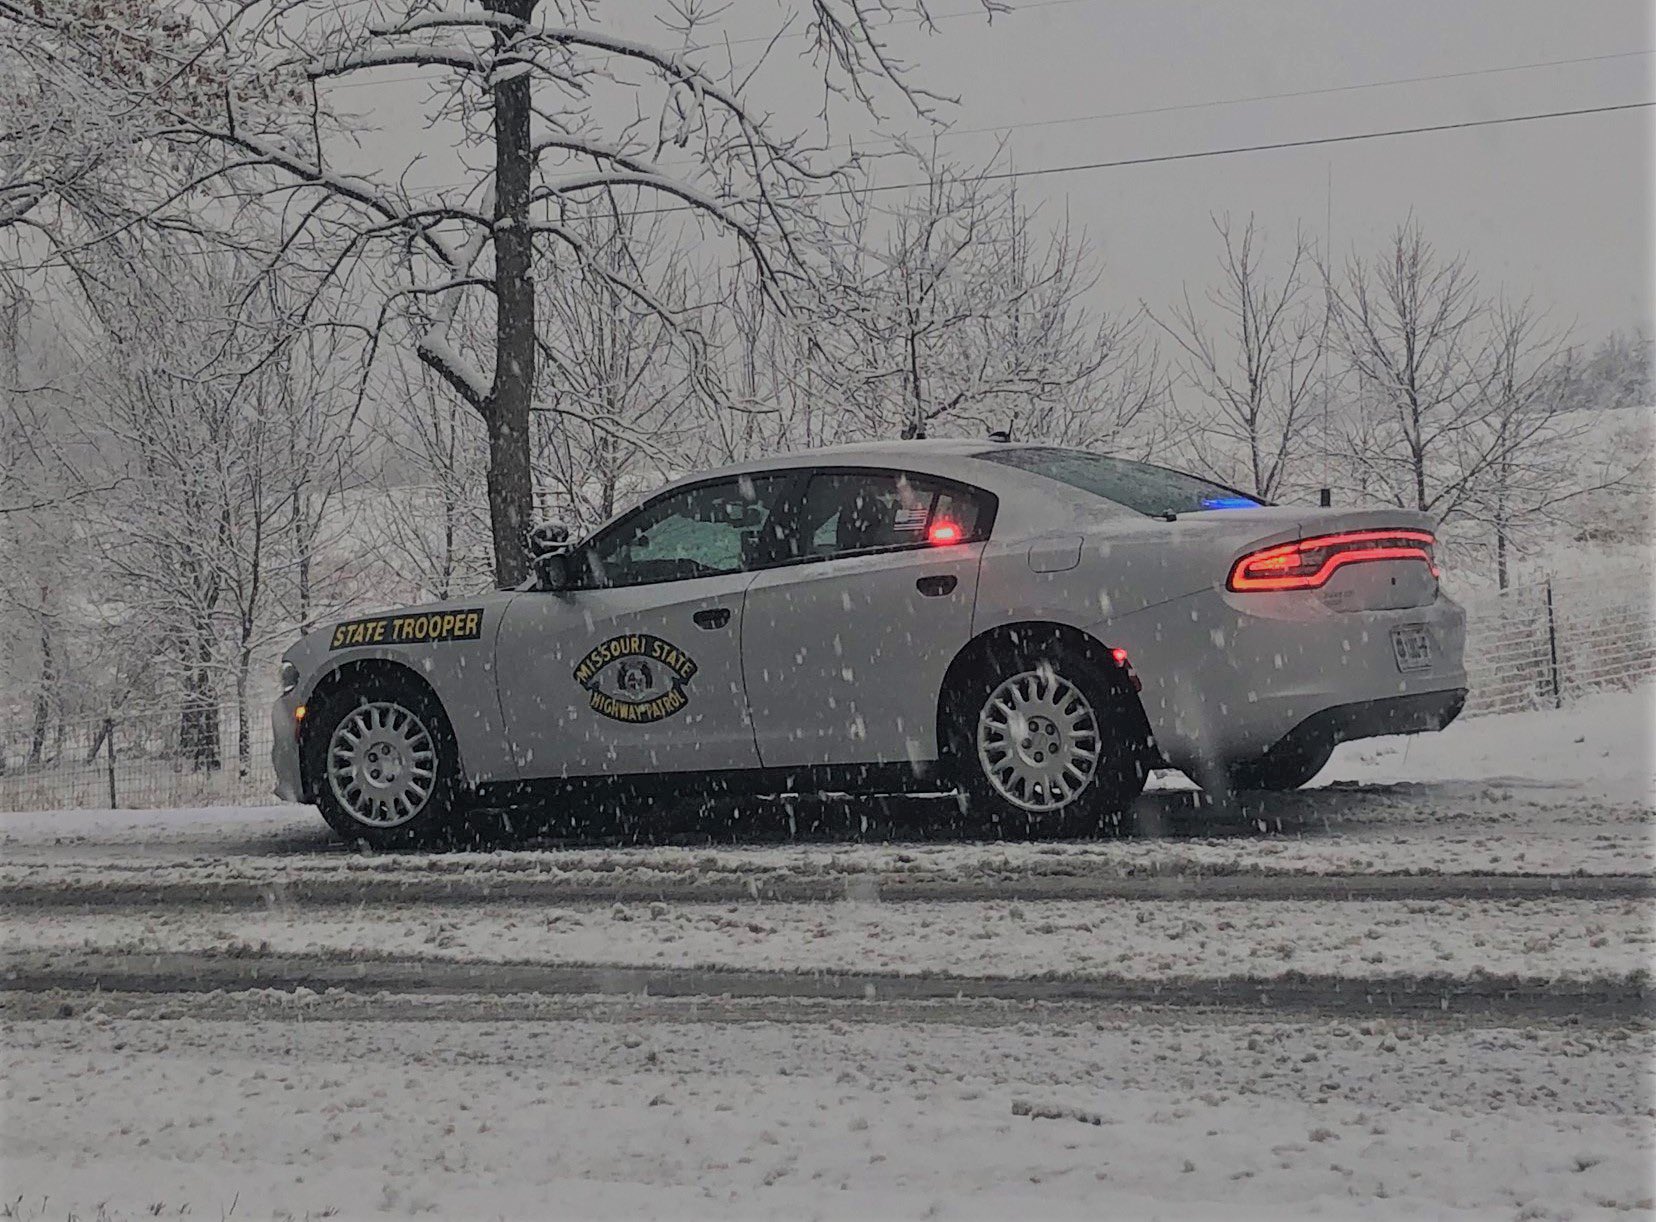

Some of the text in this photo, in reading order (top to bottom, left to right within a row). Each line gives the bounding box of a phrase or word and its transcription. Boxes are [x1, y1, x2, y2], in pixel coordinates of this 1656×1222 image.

[333, 613, 478, 647] STATE TROOPER
[576, 637, 694, 682] MISSOURI STATE
[591, 690, 685, 721] HIGHWAY PATROL
